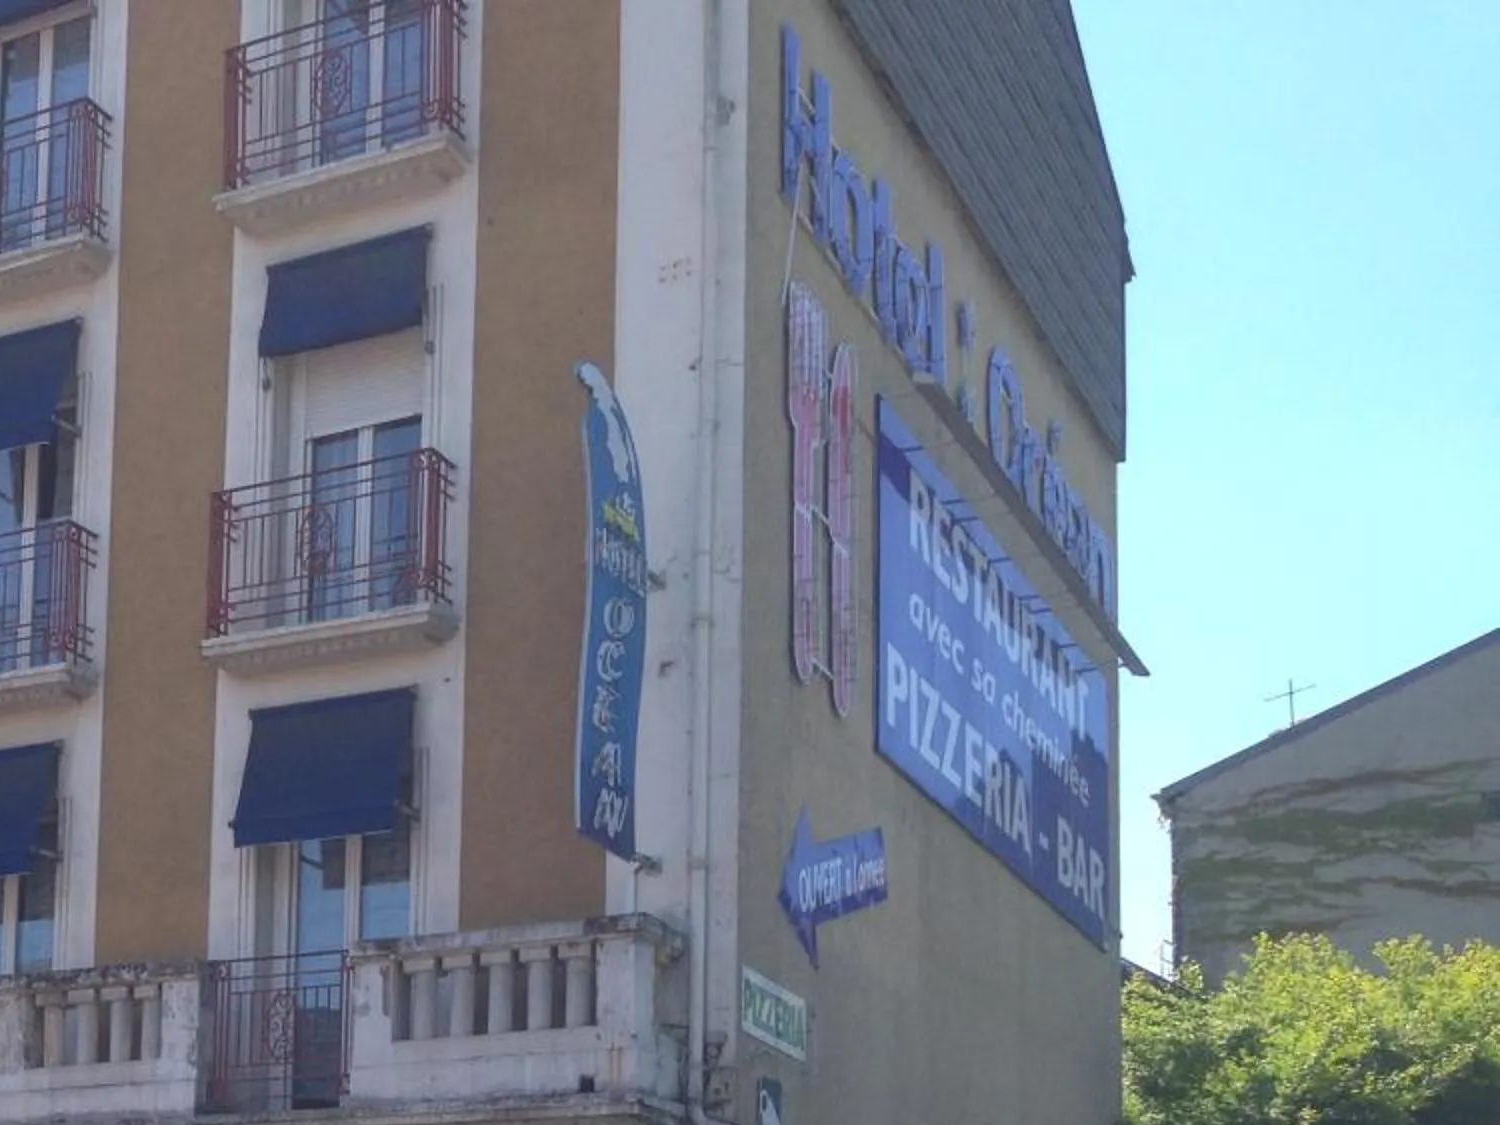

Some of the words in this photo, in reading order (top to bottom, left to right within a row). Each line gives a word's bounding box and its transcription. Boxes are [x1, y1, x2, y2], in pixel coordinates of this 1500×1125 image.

[908, 592, 964, 674] avec
[970, 657, 997, 705] sa
[909, 467, 1089, 742] RESTAURANT
[886, 641, 1033, 860] PIZZERIA
[1056, 815, 1105, 922] BAR
